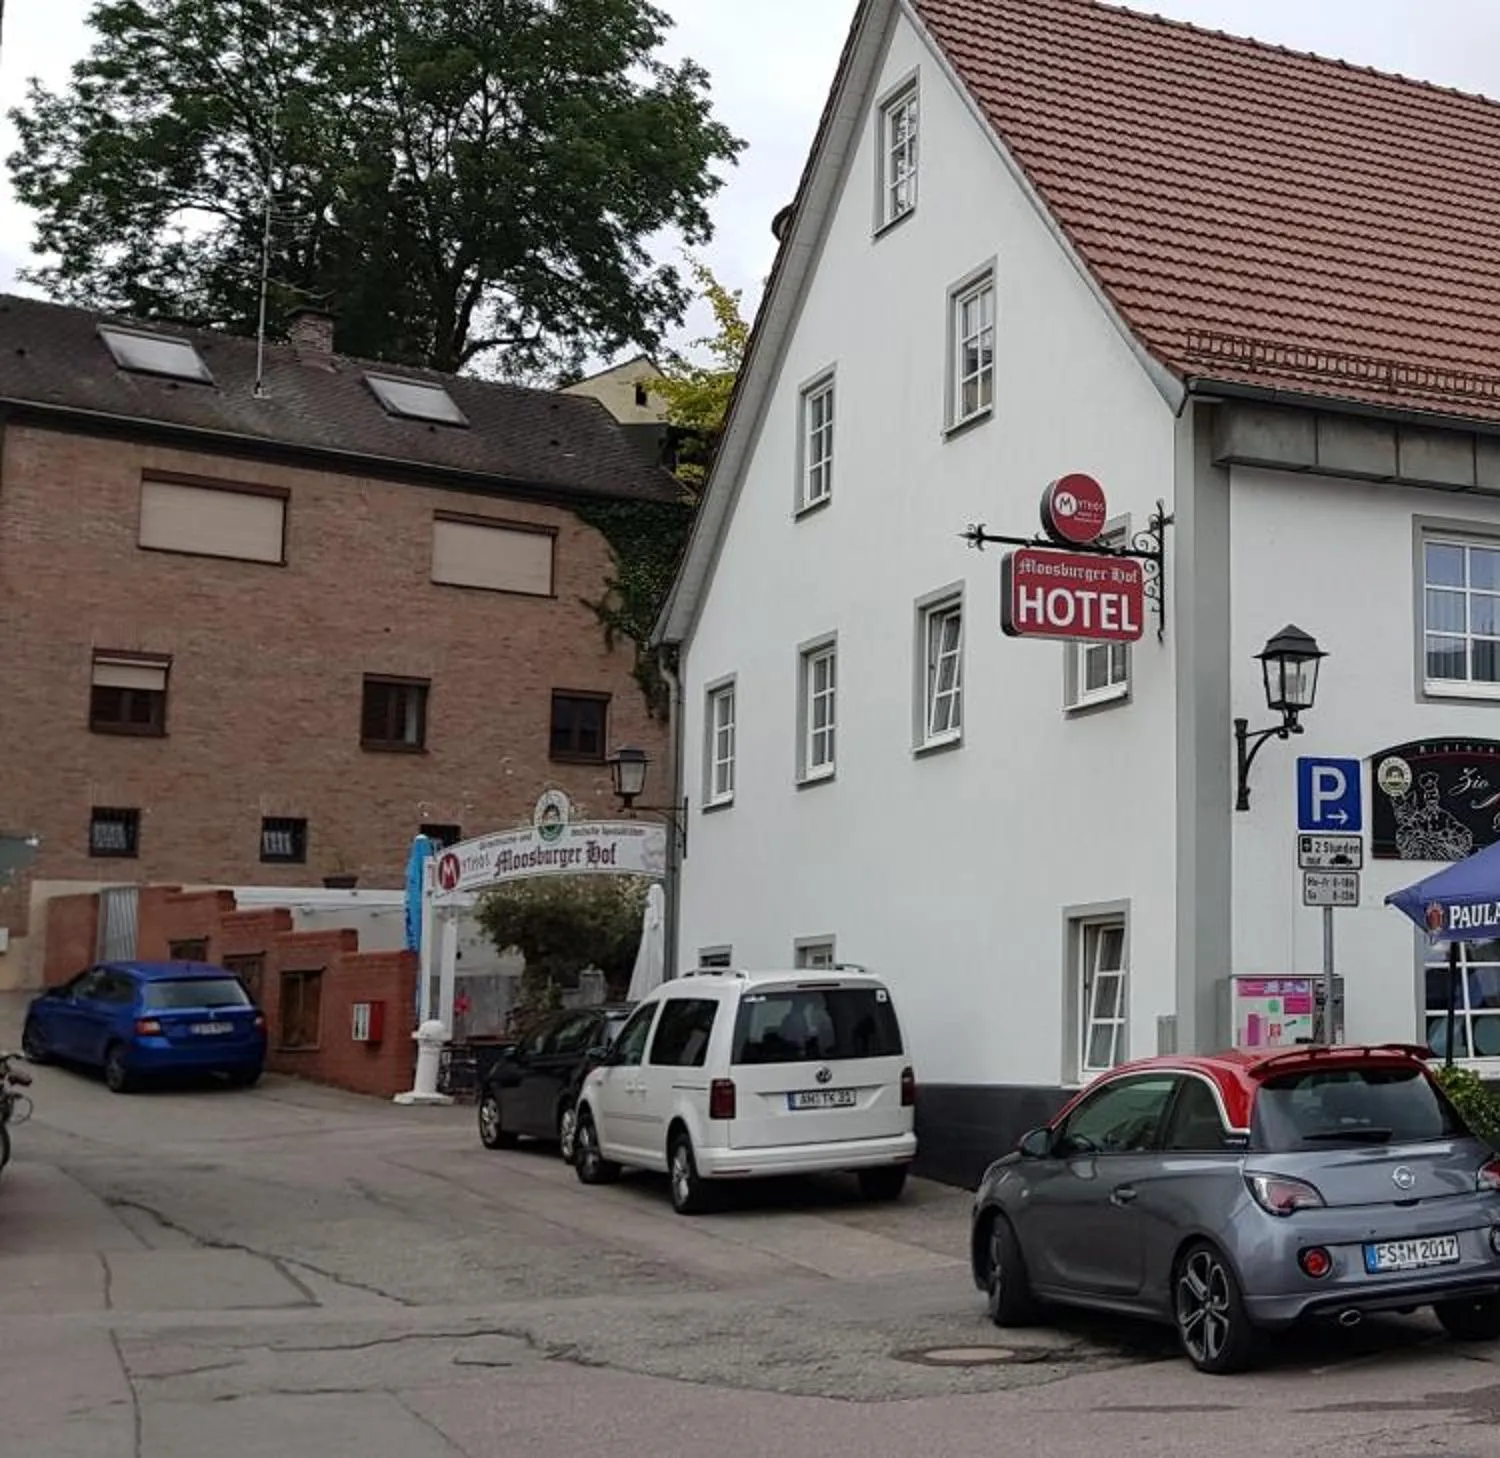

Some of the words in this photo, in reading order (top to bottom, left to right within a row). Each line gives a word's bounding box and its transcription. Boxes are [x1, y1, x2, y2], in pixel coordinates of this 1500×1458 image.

[1019, 558, 1108, 582] Moosburger
[1111, 567, 1138, 584] Hof
[1019, 585, 1139, 632] HOTEL
[1312, 766, 1347, 822] P
[494, 845, 583, 877] Moosburger
[586, 840, 617, 866] Hof
[1315, 841, 1321, 853] 2
[1324, 841, 1359, 854] Stunden
[1377, 1245, 1397, 1264] FS
[1407, 1244, 1418, 1259] M
[1421, 1237, 1455, 1260] 2017
